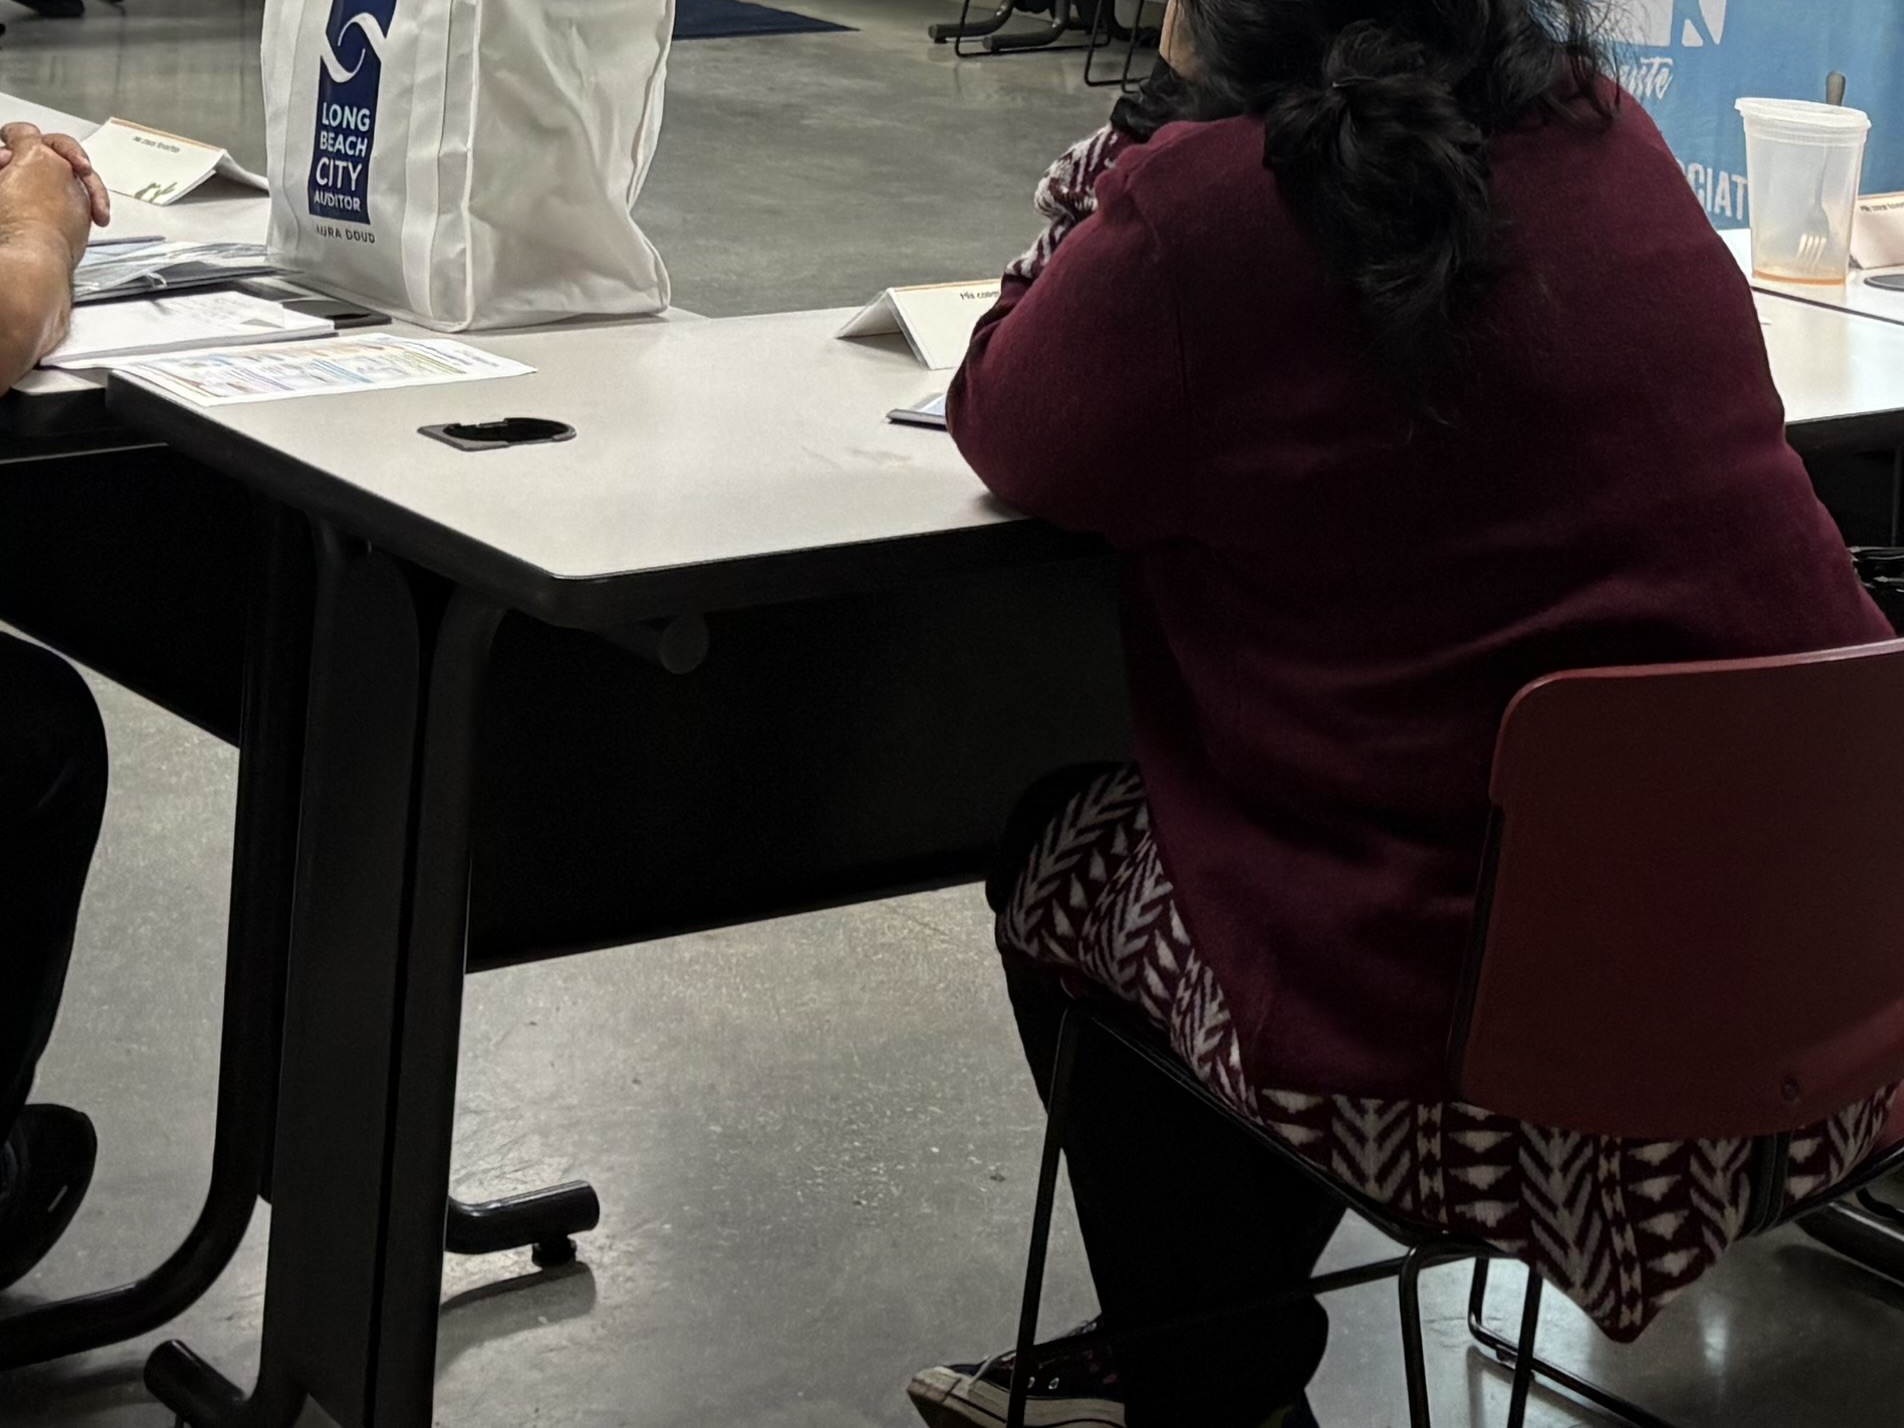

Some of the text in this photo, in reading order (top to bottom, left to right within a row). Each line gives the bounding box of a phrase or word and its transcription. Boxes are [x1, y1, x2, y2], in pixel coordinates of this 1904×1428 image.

[321, 102, 371, 132] LONG
[319, 130, 368, 158] BEACH
[315, 156, 363, 192] CITY
[313, 190, 361, 212] AUDITOR
[345, 229, 376, 244] DOUD
